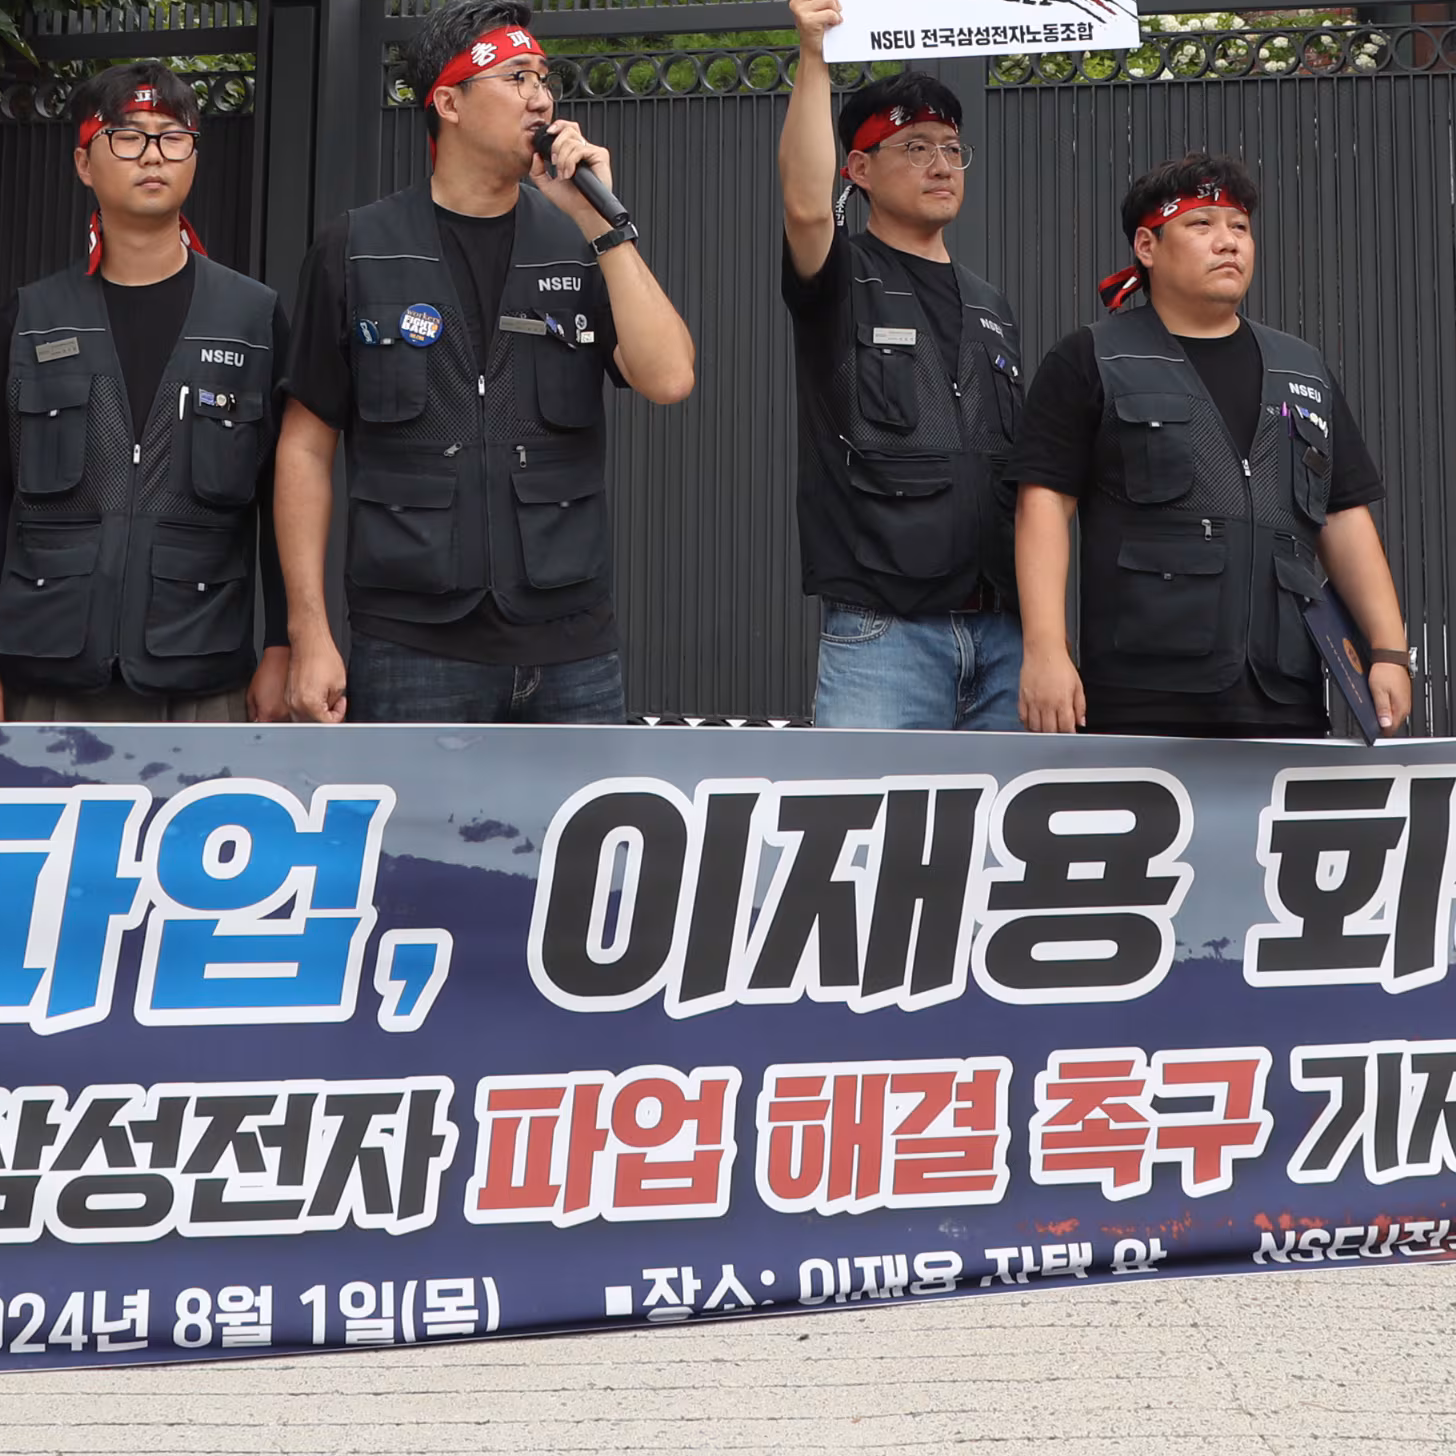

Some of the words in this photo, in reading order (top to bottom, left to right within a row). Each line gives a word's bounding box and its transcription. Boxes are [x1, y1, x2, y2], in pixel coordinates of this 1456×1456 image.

[870, 30, 915, 51] NSEU
[920, 23, 1094, 48] 전국삼성전자노동조합
[538, 277, 582, 292] NSEU
[201, 349, 245, 367] NSEU
[1289, 382, 1322, 404] NSEU
[528, 767, 1195, 1019] 이재용
[464, 1063, 742, 1228] 파업
[754, 1055, 1014, 1215] 해결
[1030, 1045, 1273, 1201] 촉구
[798, 1250, 964, 1305] 이재용
[171, 1285, 273, 1349] 8월
[297, 1276, 502, 1345] 1일(목)
